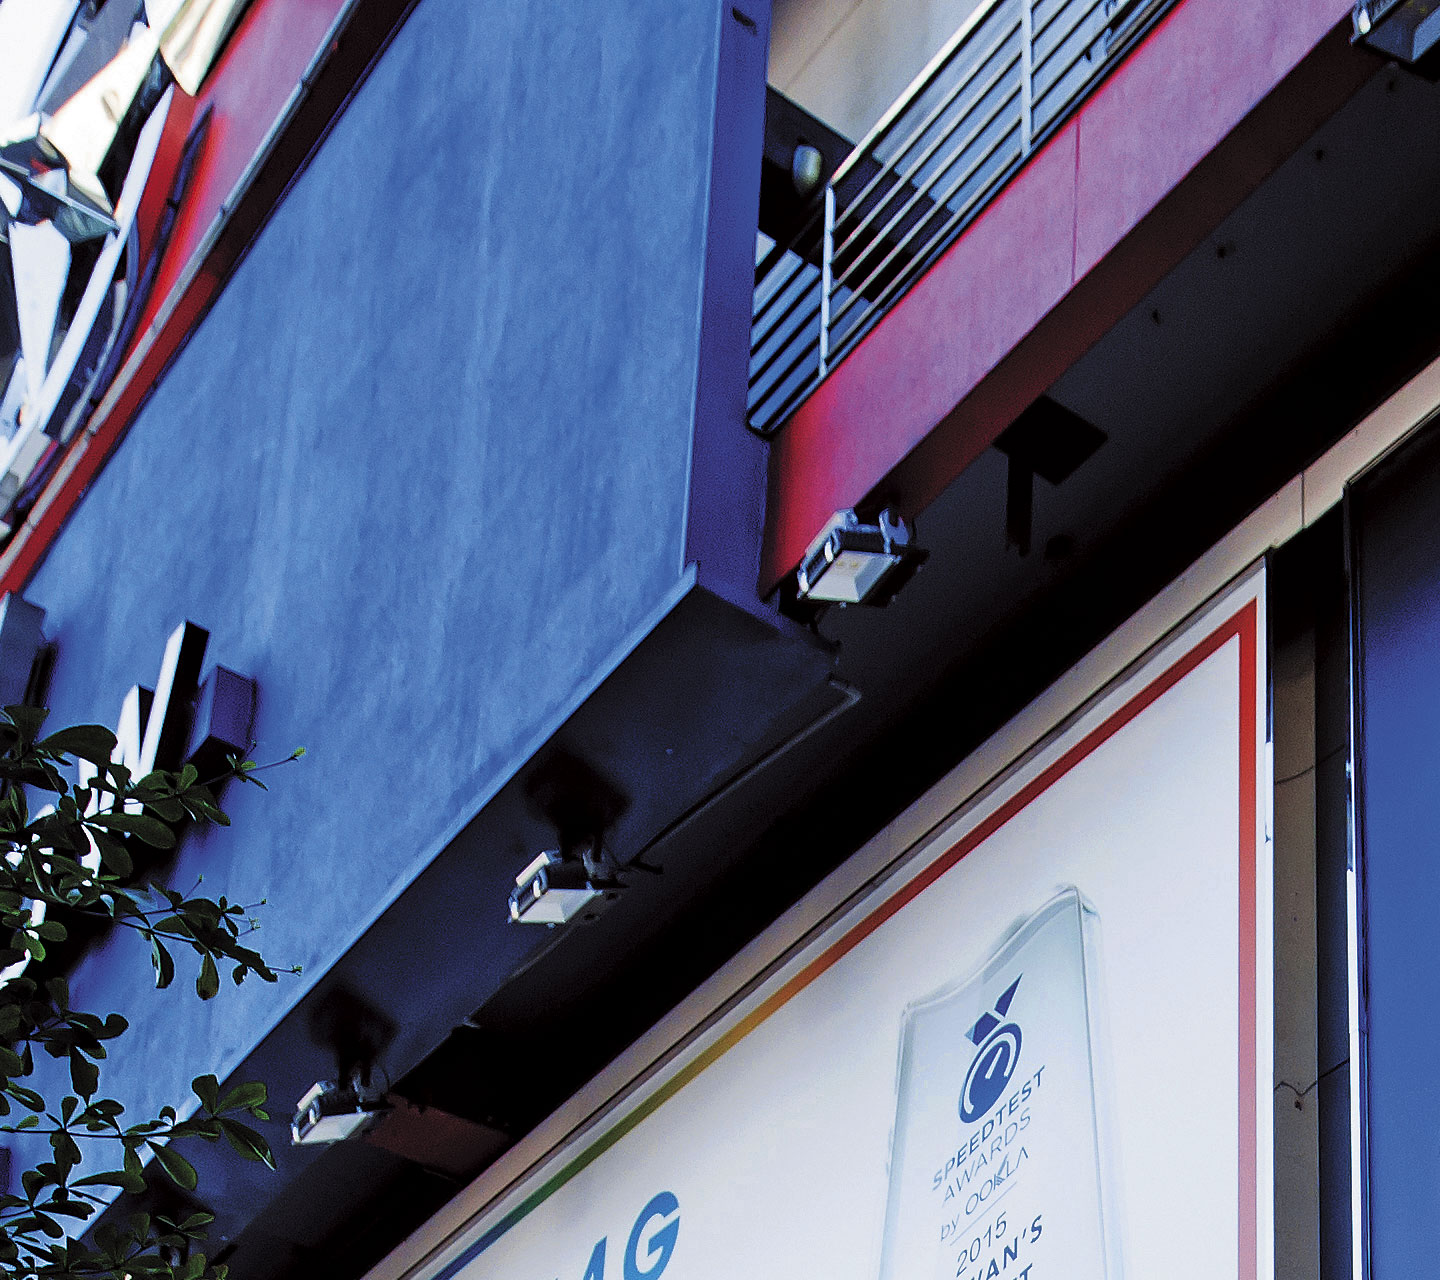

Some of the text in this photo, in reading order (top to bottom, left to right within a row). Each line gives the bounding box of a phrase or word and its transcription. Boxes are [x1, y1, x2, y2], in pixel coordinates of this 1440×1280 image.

[933, 1066, 1046, 1191] SPEEDTEST
[942, 1108, 1032, 1204] AWARDS
[939, 1147, 1030, 1243] by OOKLA
[956, 1218, 1010, 1277] 2015
